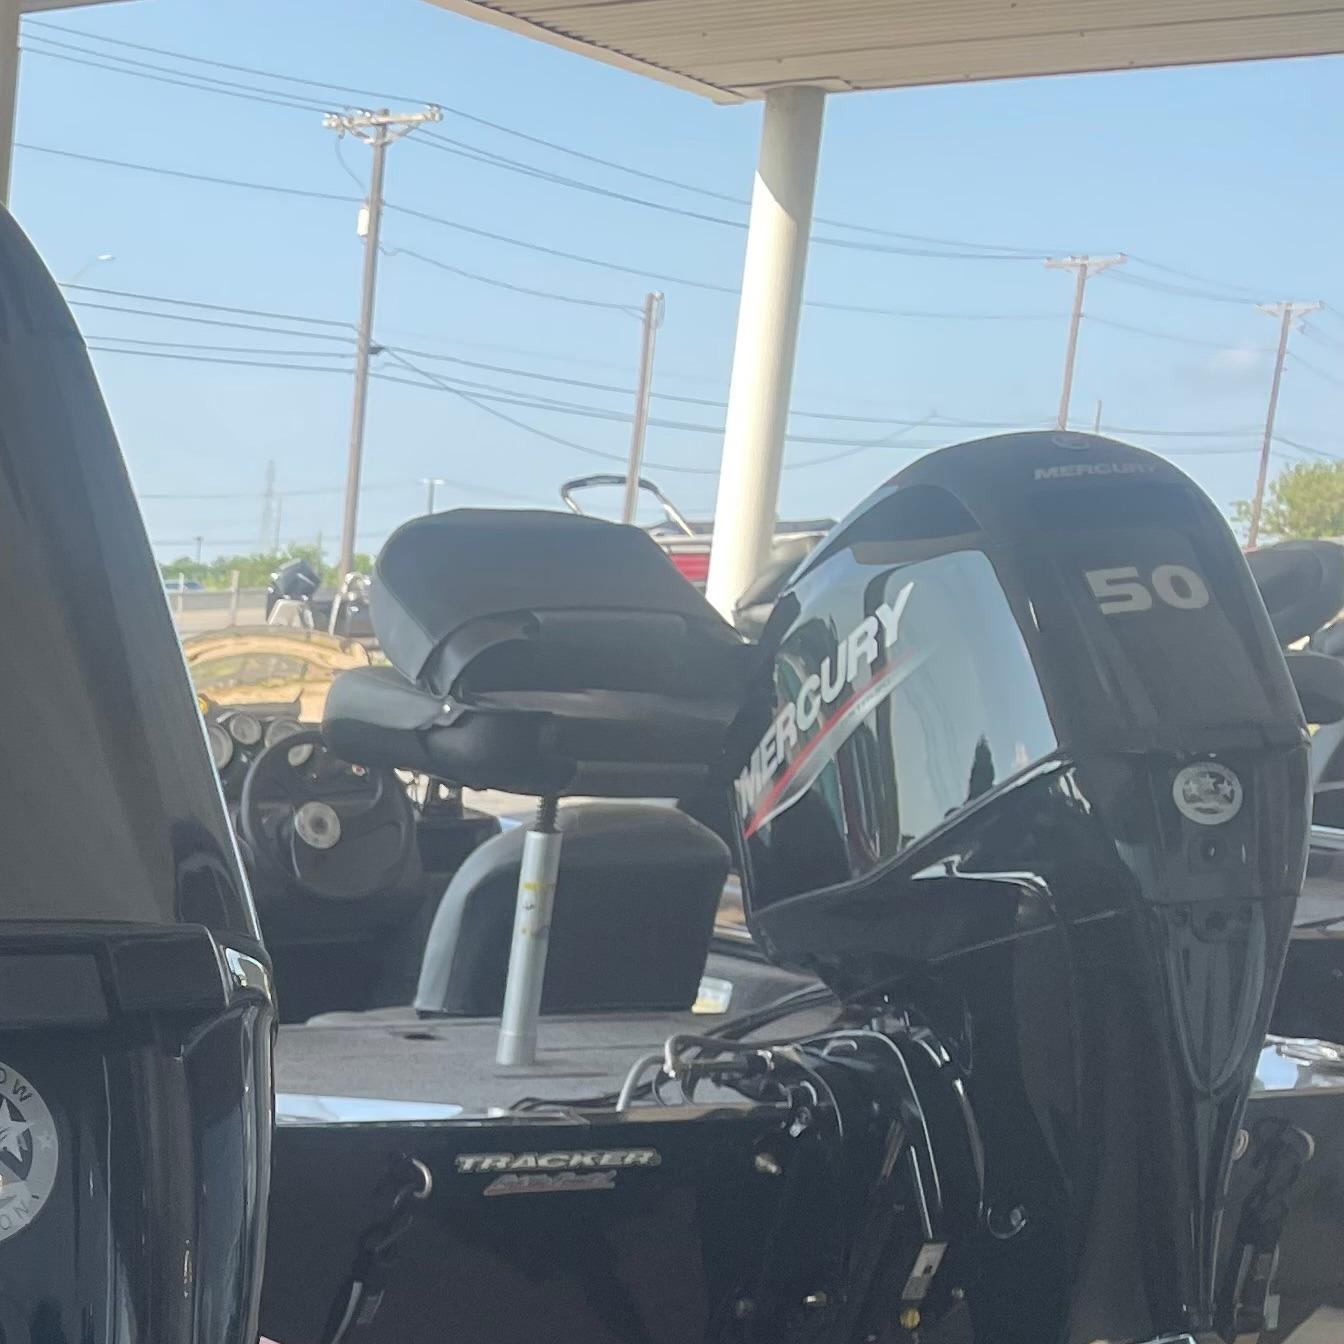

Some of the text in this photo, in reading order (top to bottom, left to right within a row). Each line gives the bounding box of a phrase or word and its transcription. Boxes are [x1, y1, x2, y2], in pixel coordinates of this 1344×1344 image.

[1034, 462, 1157, 481] MERCURY
[1085, 564, 1210, 615] 50
[733, 581, 914, 818] MERCURY
[457, 1149, 658, 1172] TRACKER
